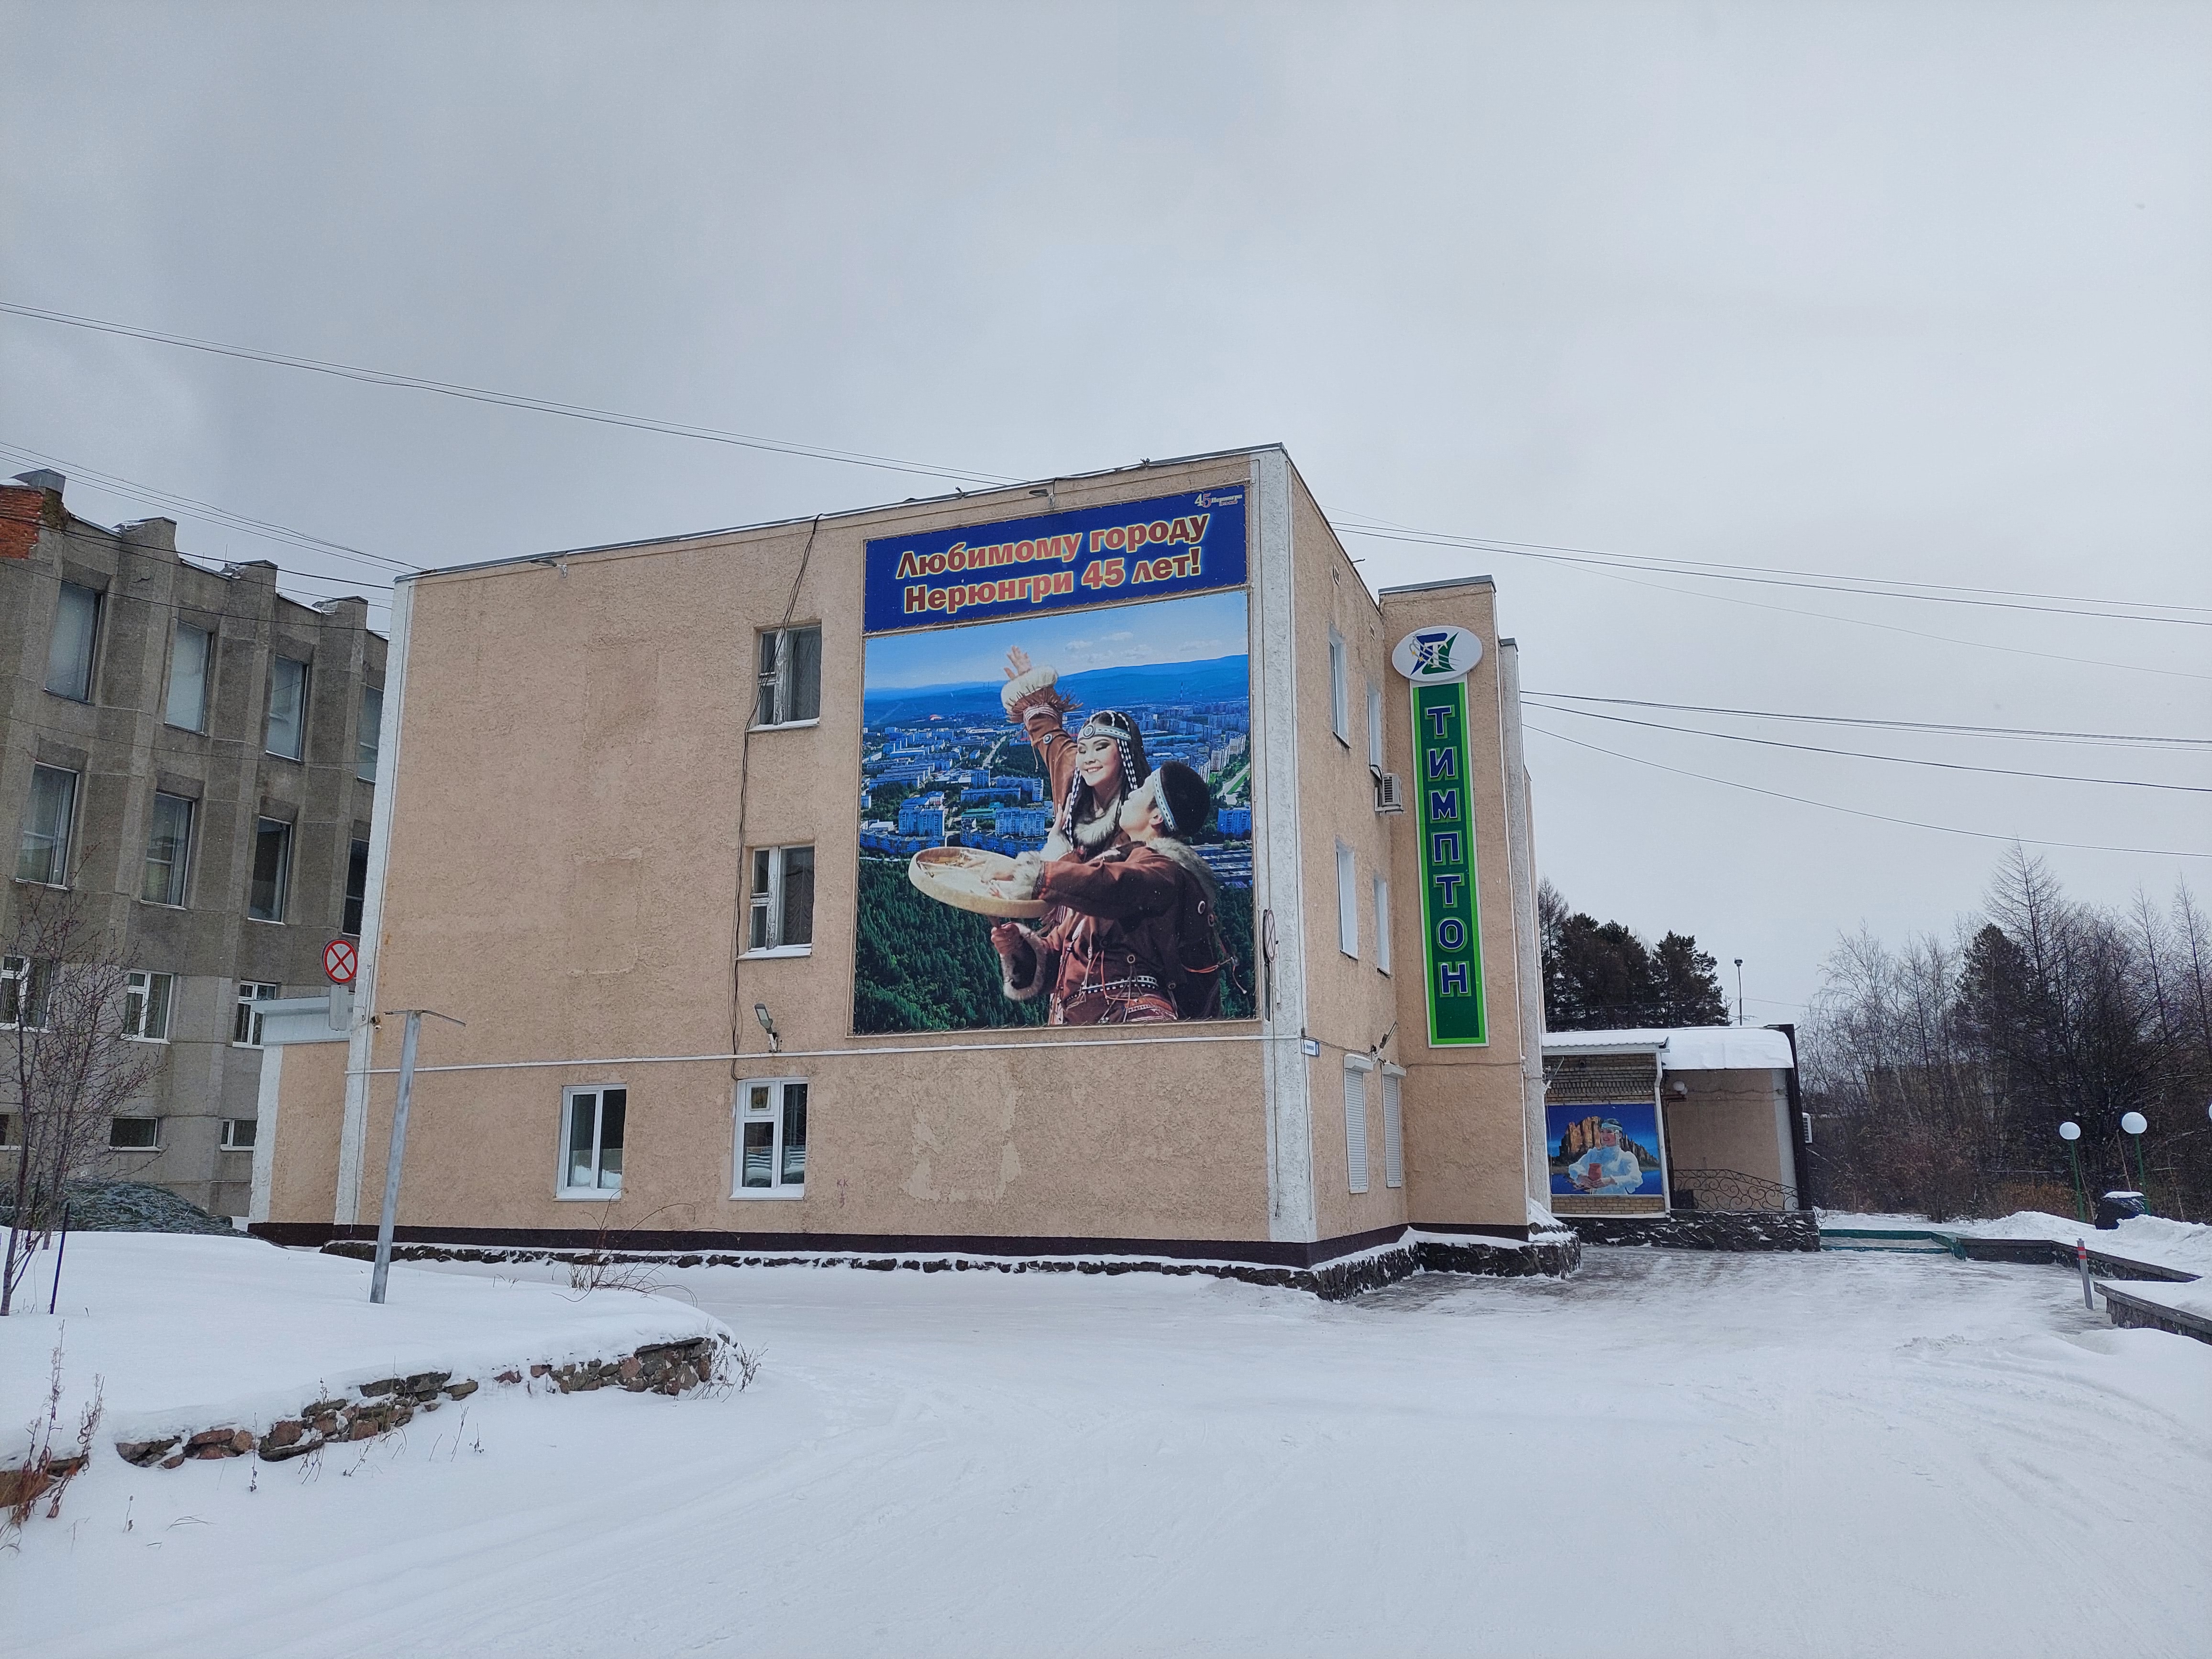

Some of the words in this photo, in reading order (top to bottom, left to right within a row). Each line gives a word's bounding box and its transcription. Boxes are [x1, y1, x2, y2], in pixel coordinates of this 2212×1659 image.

[1194, 493, 1212, 508] 45
[896, 532, 1083, 579] Любимому
[1090, 513, 1210, 553] городу
[904, 571, 1074, 614] Нерюнгри
[1081, 557, 1125, 589] 45
[1131, 546, 1201, 584] лет!
[1426, 706, 1469, 995] ТИМПТОН
